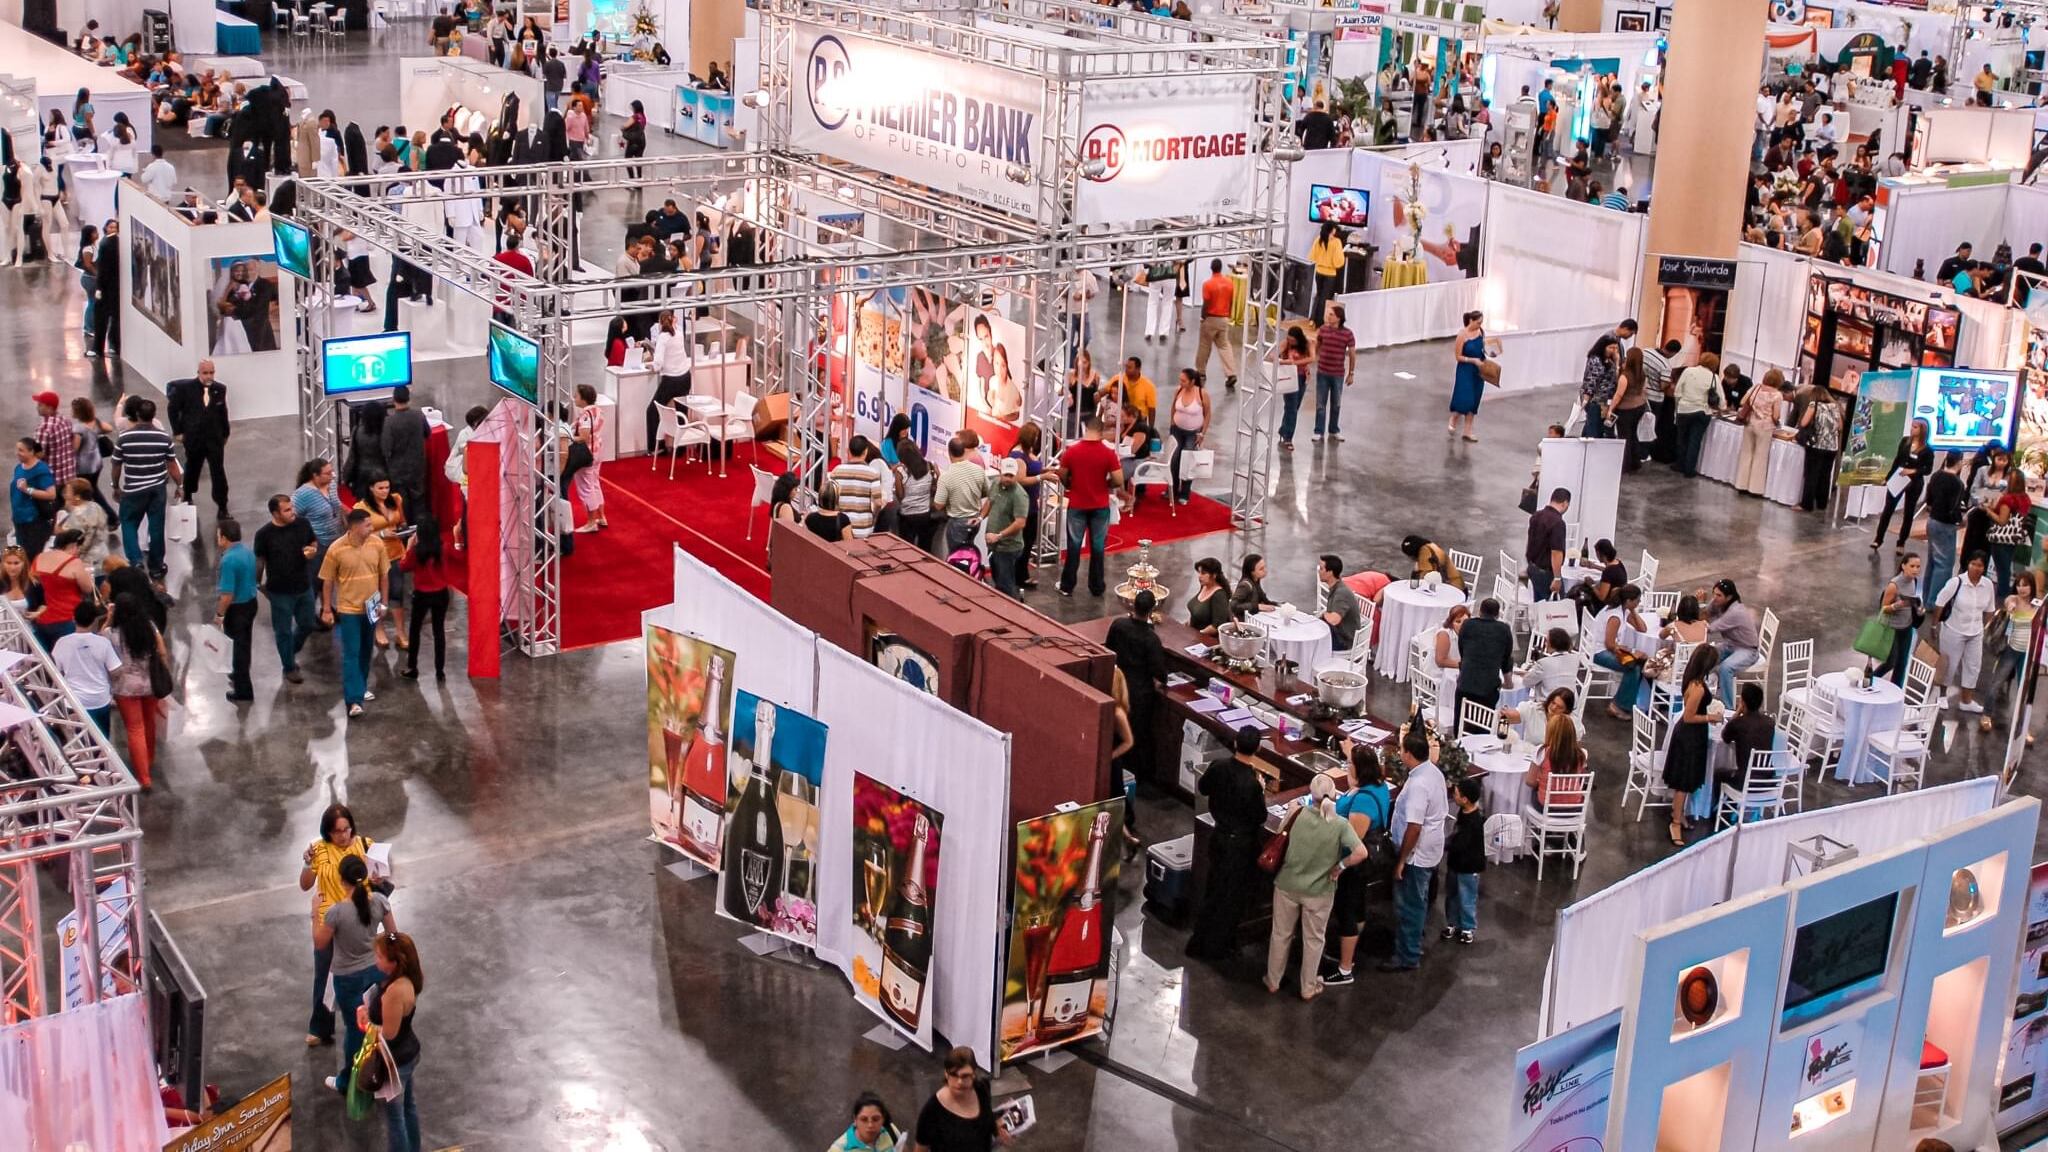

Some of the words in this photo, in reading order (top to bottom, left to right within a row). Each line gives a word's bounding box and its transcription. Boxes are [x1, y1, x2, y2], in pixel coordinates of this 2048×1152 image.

[1361, 15, 1380, 24] STAR
[964, 96, 1034, 166] BANK
[854, 123, 876, 141] OF
[888, 133, 968, 168] PUERTO
[1088, 137, 1120, 169] R-G
[1132, 132, 1247, 162] MORTGAGE
[1660, 260, 1680, 272] José
[1683, 260, 1729, 278] Sepúlveda
[1560, 1077, 1580, 1092] LINE
[213, 1121, 236, 1141] Inn
[239, 1107, 259, 1125] San
[259, 1091, 284, 1114] Juan
[226, 1128, 251, 1146] PUERTO
